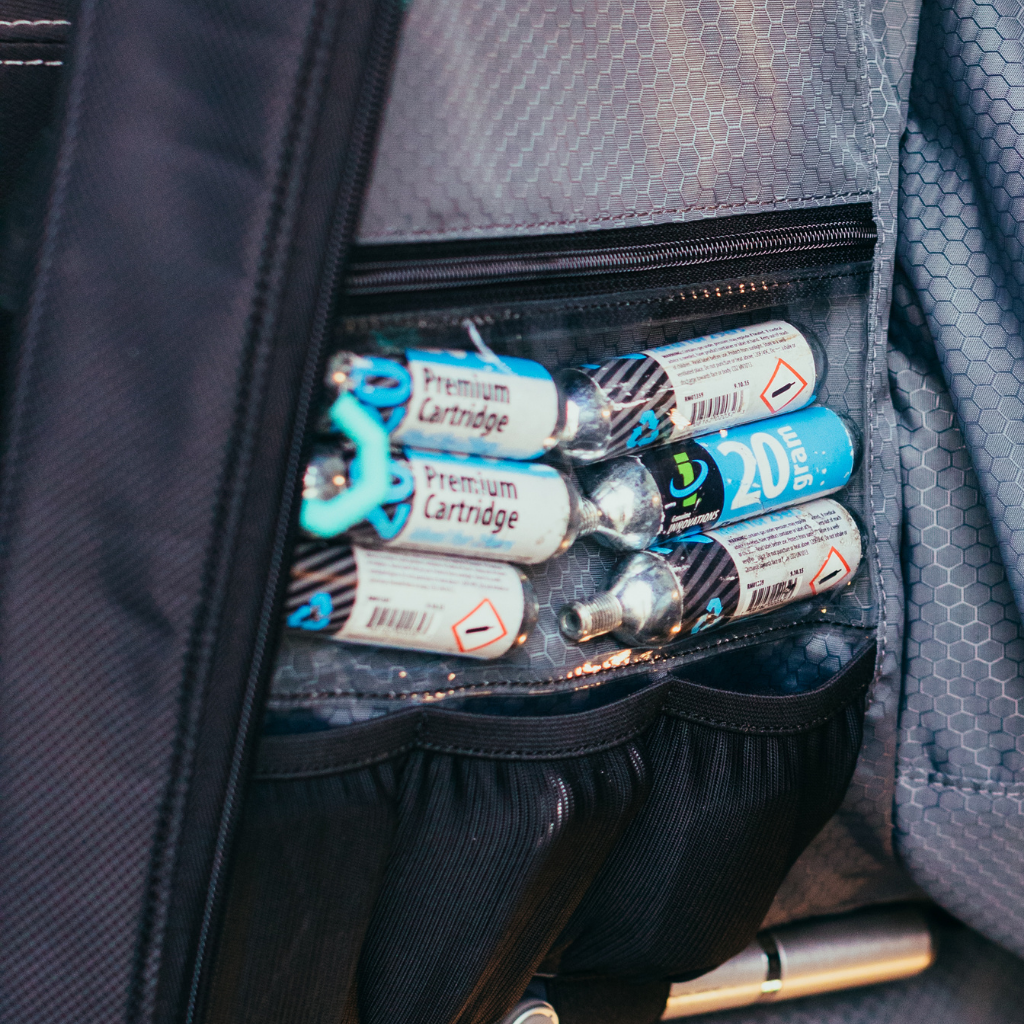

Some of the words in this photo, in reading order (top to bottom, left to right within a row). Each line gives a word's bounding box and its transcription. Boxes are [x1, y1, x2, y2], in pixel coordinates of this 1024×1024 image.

[423, 367, 510, 404] Premium
[418, 397, 509, 436] Cartridge
[716, 432, 790, 510] 20
[777, 425, 813, 491] gram
[424, 466, 518, 499] Premium
[424, 494, 519, 534] Cartridge
[666, 509, 720, 534] INNOVATIONS
